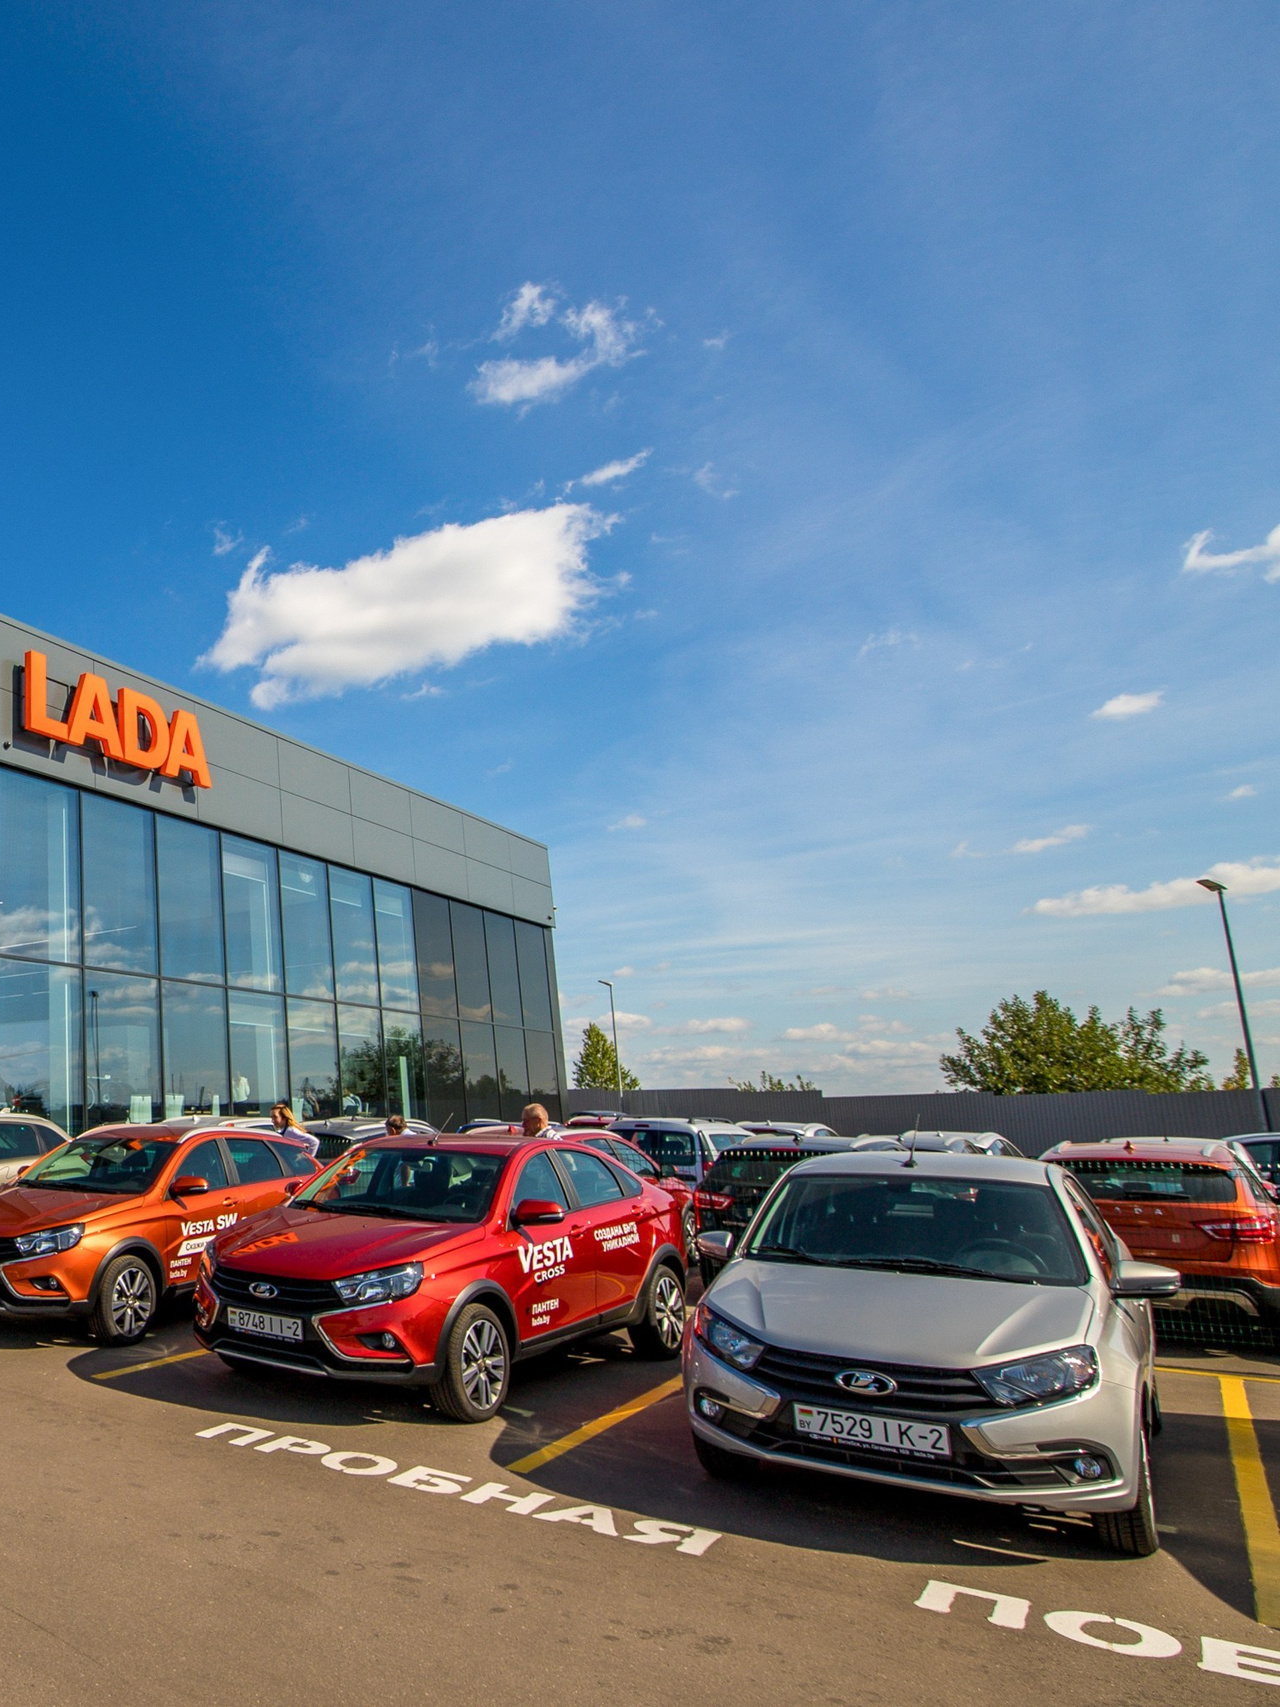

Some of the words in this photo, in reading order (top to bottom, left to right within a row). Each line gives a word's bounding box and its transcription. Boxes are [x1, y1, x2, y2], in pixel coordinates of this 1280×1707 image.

[24, 649, 212, 789] LADA
[181, 1219, 215, 1237] VESTA
[216, 1212, 238, 1230] SW
[594, 1225, 624, 1241] СОЗДАНА
[623, 1221, 639, 1235] БЫТЬ
[170, 1257, 192, 1269] ПАНТЕН
[517, 1236, 574, 1274] VESTA
[170, 1268, 188, 1279] lada.by
[534, 1264, 566, 1283] CROSS
[532, 1298, 559, 1315] ПАНТЕН
[238, 1311, 265, 1331] 8748
[531, 1315, 551, 1327] lada.by
[799, 1420, 812, 1429] BY
[816, 1410, 873, 1439] 7529
[195, 1422, 722, 1557] ПРОБНАЯ
